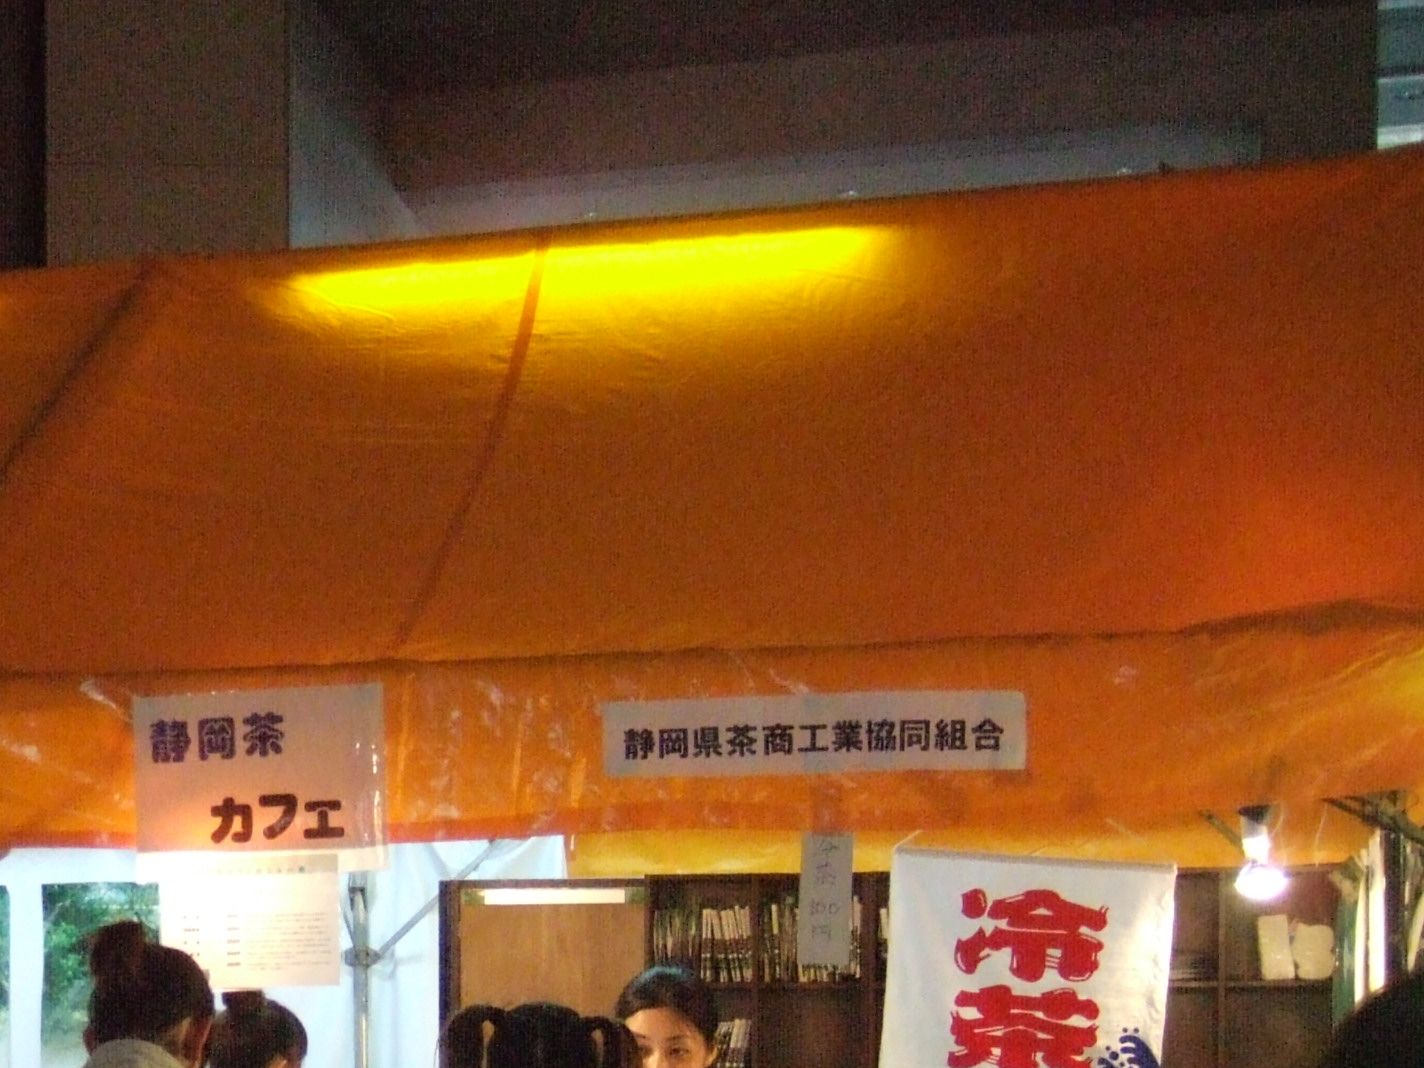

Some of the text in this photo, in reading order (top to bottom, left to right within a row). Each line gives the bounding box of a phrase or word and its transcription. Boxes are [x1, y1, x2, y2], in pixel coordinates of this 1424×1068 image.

[150, 711, 285, 763] 静岡茶
[622, 717, 1005, 761] 静岡県茶商工業協同組合
[210, 793, 345, 844] カフェ
